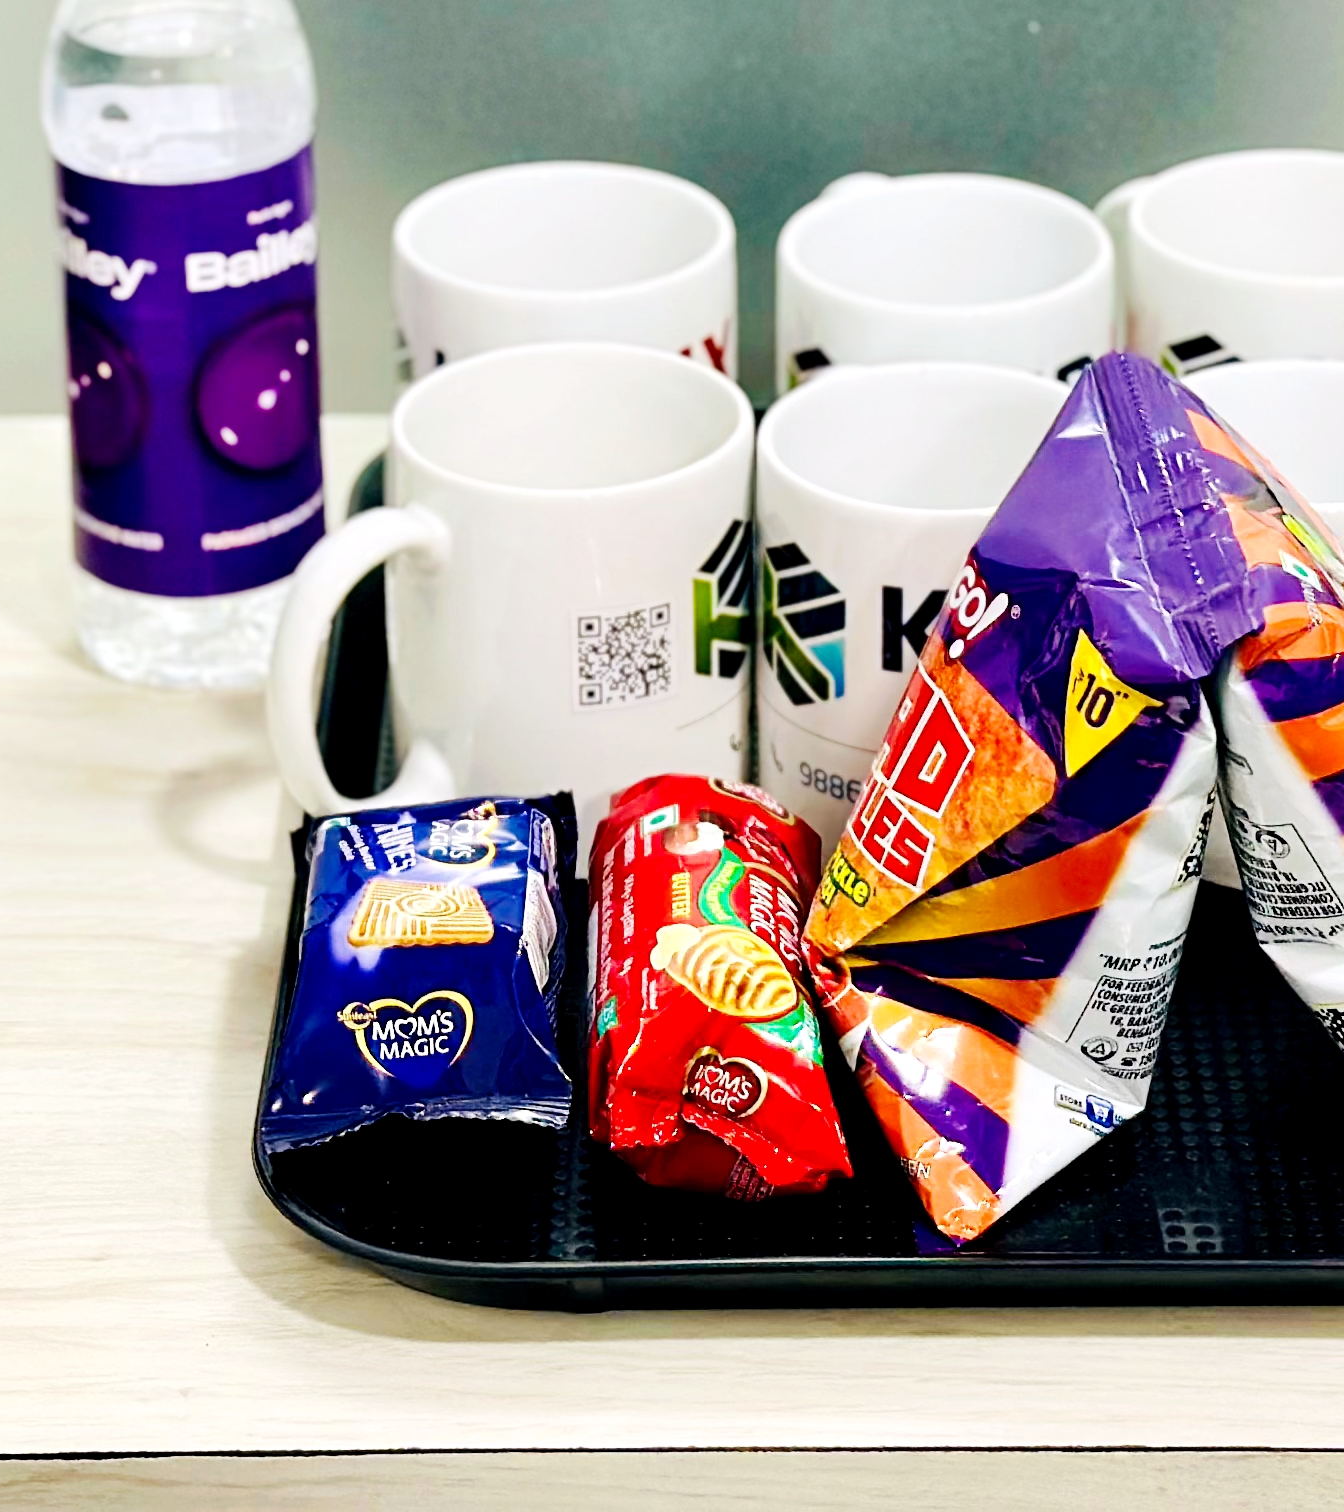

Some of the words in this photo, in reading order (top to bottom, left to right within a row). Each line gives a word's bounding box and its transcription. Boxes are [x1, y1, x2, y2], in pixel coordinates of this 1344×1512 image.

[429, 821, 447, 857] AGIC
[671, 871, 691, 919] BUTTER
[1091, 1000, 1108, 1012] ITC
[1110, 1003, 1143, 1015] GREEN
[372, 1009, 454, 1041] MOM'S
[379, 1035, 450, 1060] MAGIC
